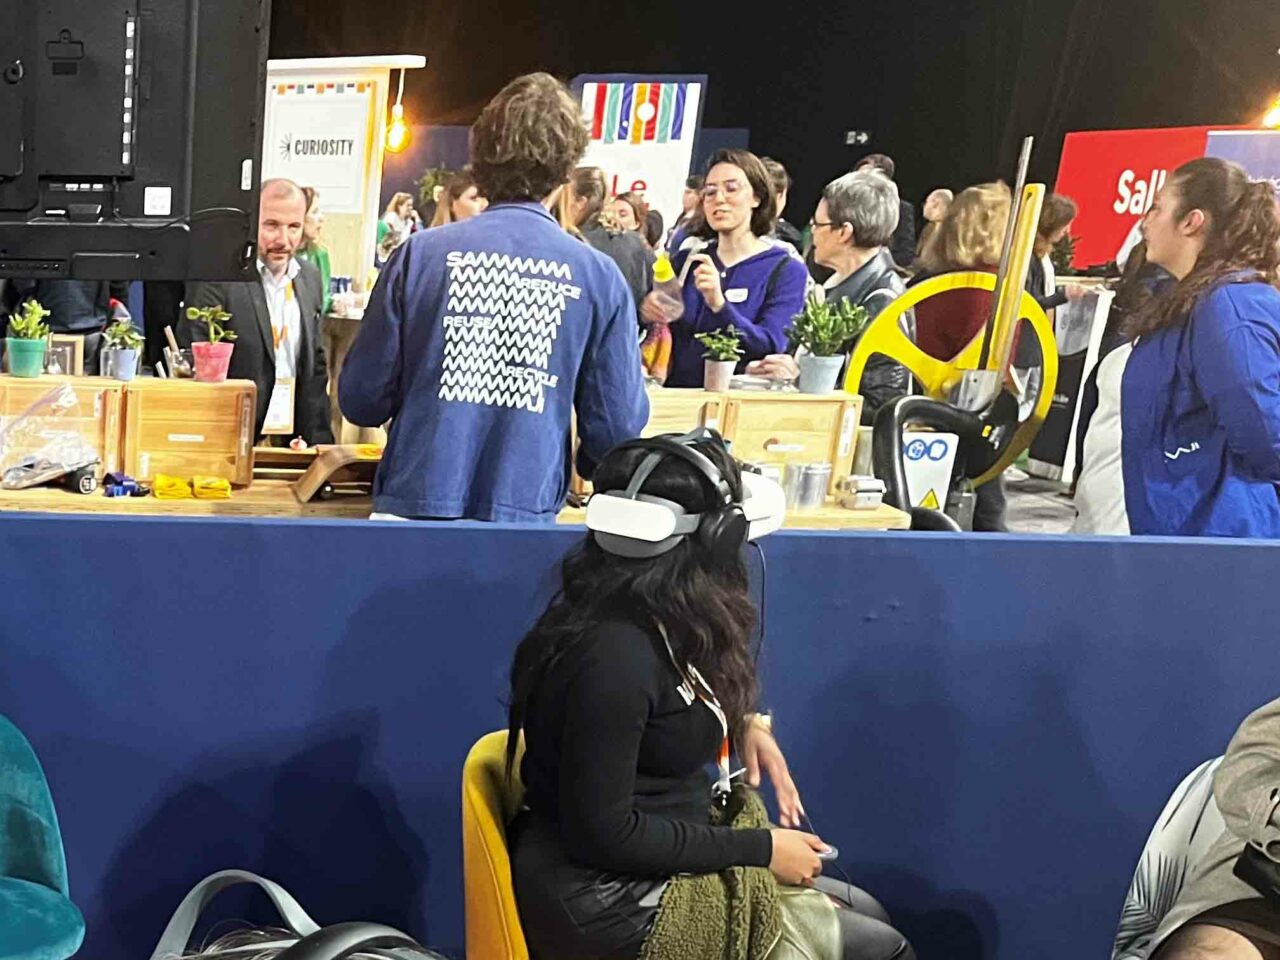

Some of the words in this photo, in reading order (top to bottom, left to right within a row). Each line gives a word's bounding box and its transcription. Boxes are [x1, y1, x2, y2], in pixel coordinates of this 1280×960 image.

[294, 139, 354, 156] CURIOSITY
[610, 174, 648, 197] Le
[519, 277, 582, 299] REDUCE
[443, 315, 492, 328] REUSE
[505, 365, 559, 388] RECYCLE
